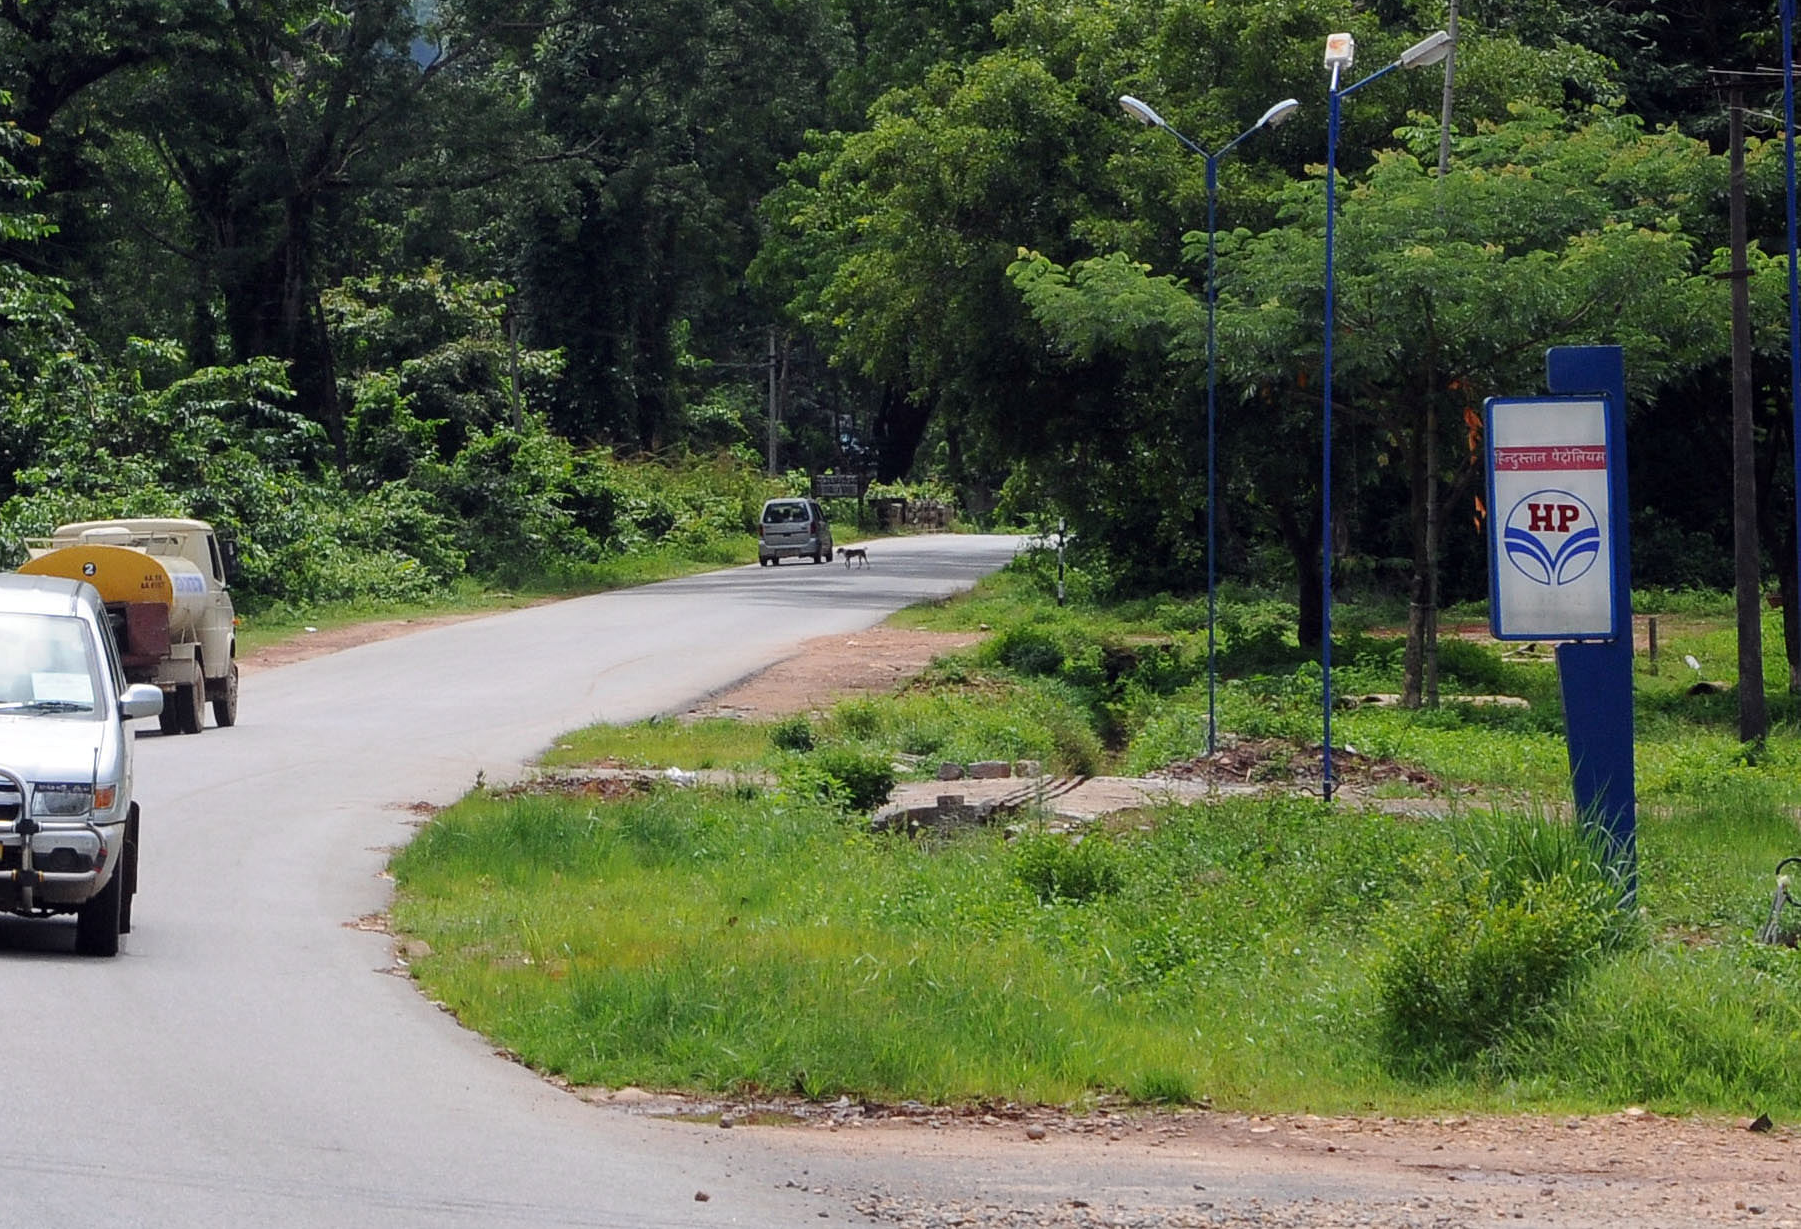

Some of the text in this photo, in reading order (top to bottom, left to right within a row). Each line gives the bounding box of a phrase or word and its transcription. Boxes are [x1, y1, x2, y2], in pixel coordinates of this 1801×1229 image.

[1494, 449, 1547, 469] हिन्दुस्तान
[1528, 503, 1580, 533] HP
[84, 563, 94, 575] 2
